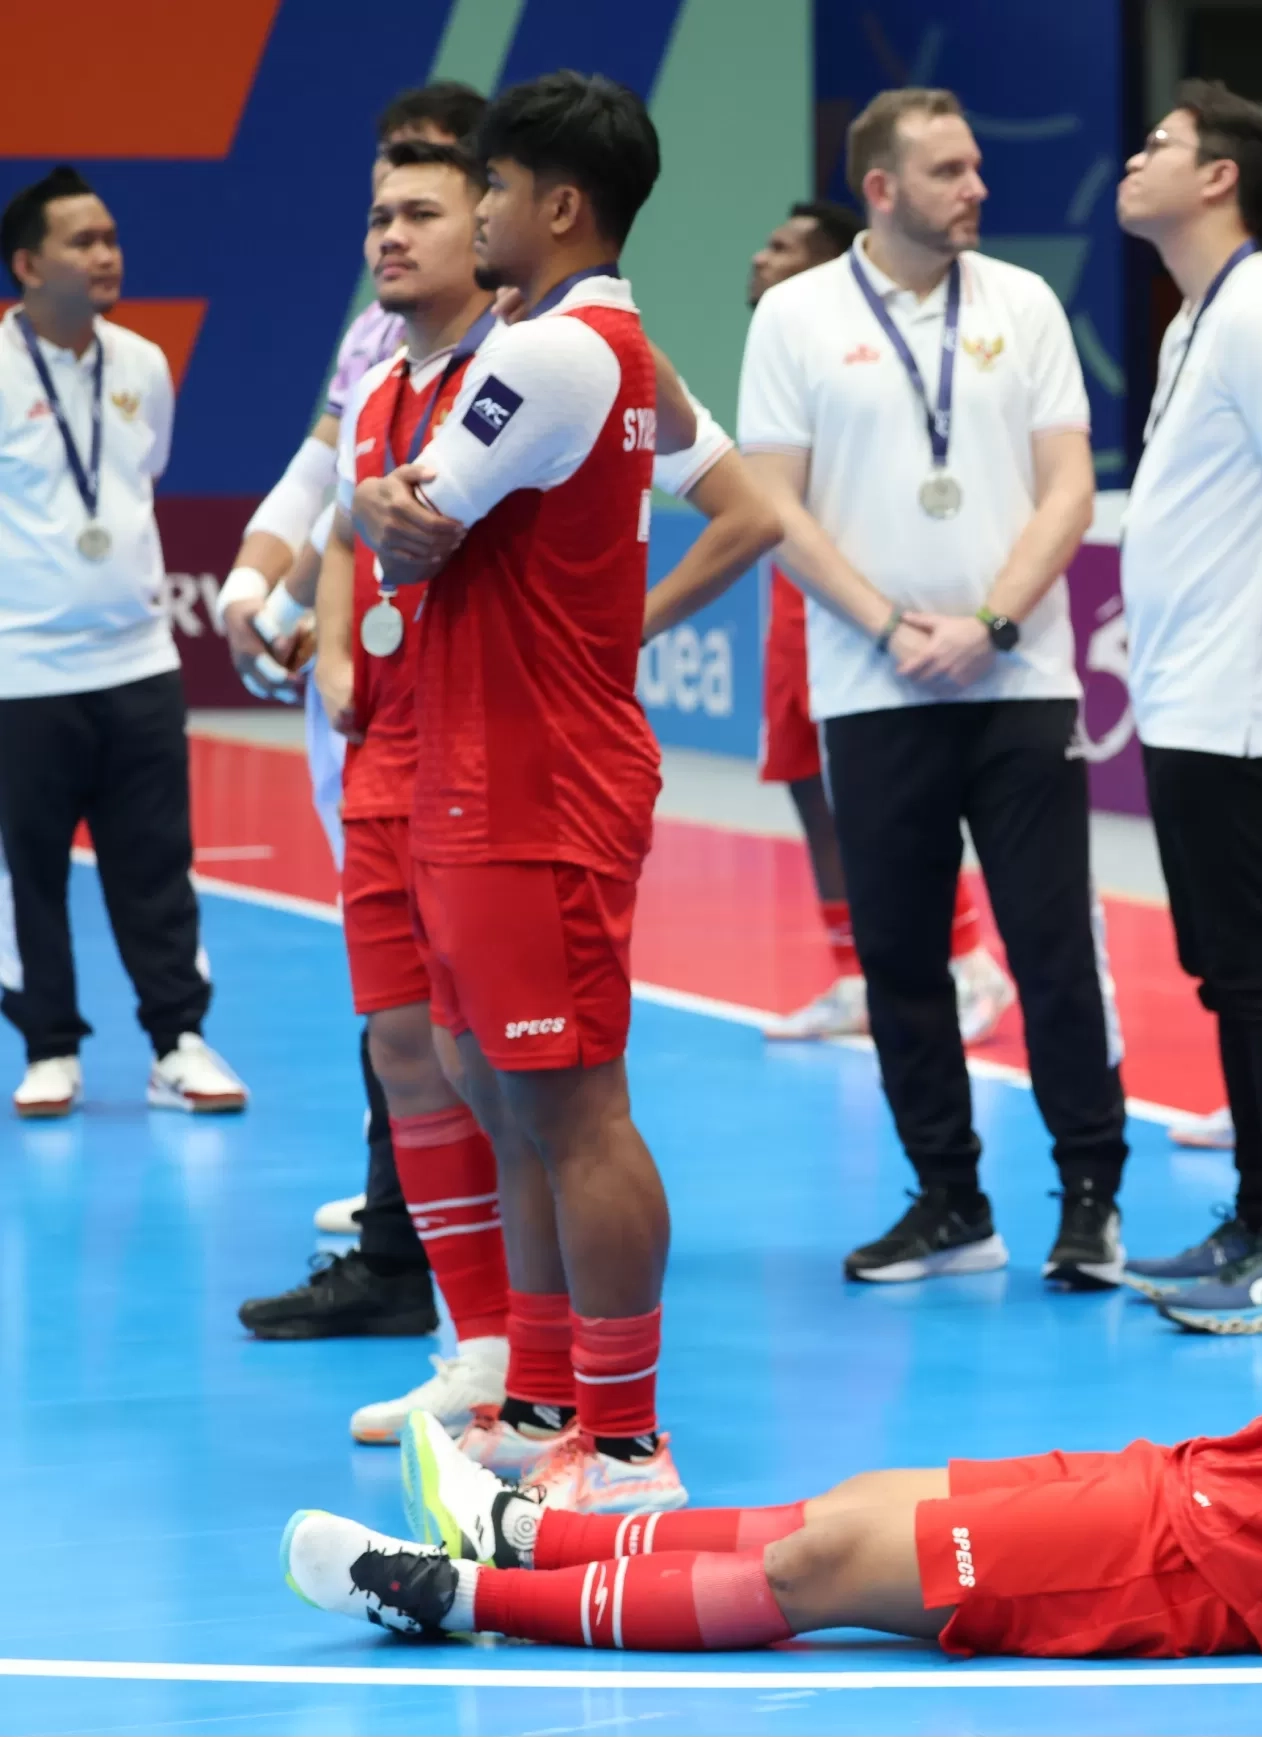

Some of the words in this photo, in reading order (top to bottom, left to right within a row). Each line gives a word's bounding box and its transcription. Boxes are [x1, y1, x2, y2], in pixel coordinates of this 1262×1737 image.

[475, 398, 510, 425] AFC
[505, 1017, 566, 1039] SPECS
[952, 1527, 975, 1587] SPECS
